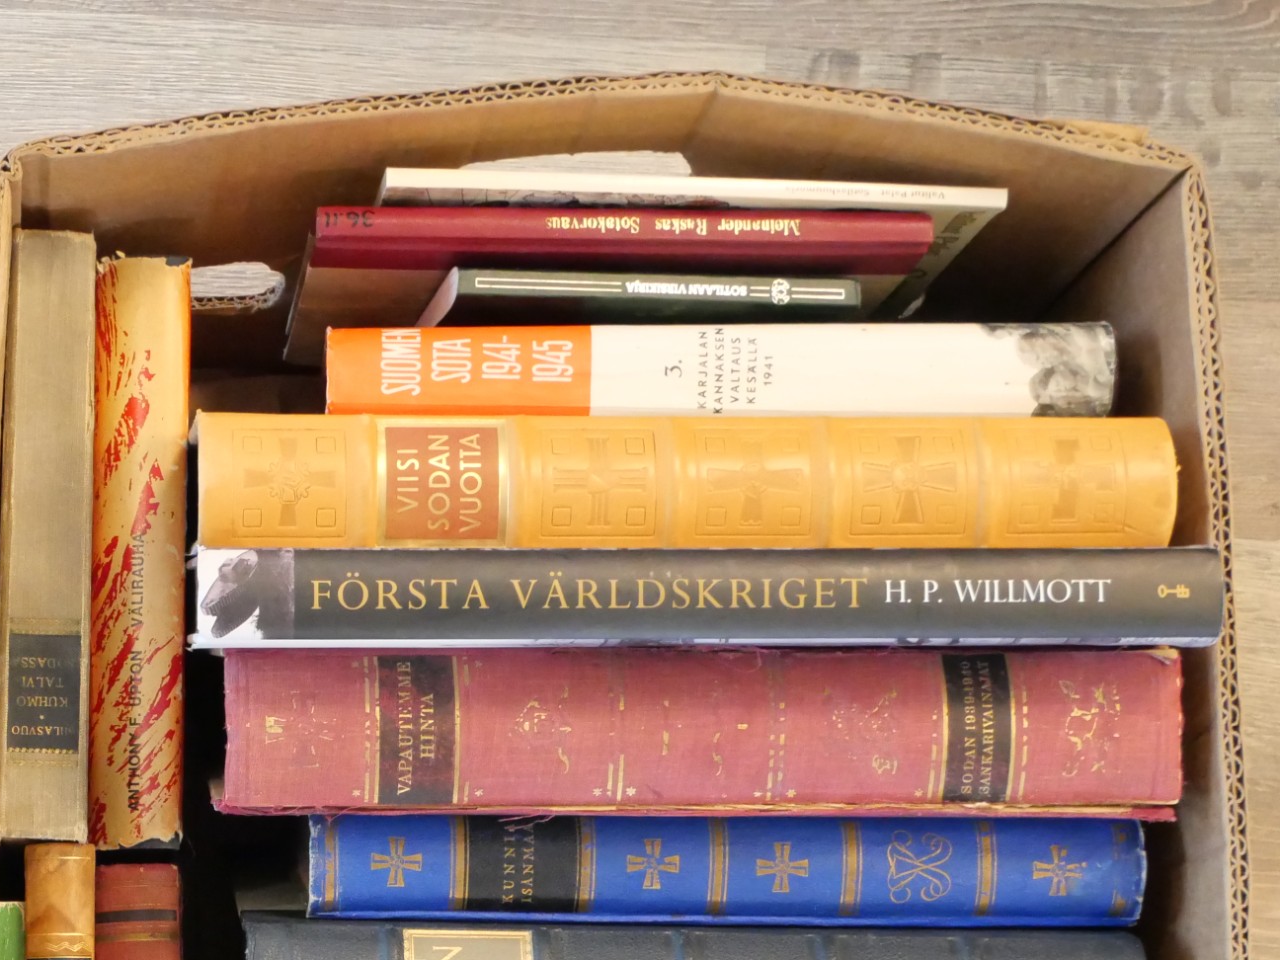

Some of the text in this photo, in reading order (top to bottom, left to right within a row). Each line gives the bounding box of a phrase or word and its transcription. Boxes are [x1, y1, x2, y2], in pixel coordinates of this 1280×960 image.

[544, 215, 801, 236] Meinander Raskas Sotakorvaus
[625, 280, 748, 297] SOTILAAN VIRSIKIRJA
[380, 328, 422, 396] SUOMEN
[430, 338, 472, 384] SOTA
[481, 335, 522, 380] 1941-
[532, 339, 574, 383] 1945
[663, 359, 683, 379] 3.
[697, 331, 708, 409] KARJALAN
[712, 327, 724, 415] KANNAKSEN
[729, 337, 741, 404] VALTAUS
[763, 356, 774, 387] 1941
[396, 449, 421, 513] VIISI
[427, 434, 451, 531] SODAN
[458, 432, 483, 534] VUOTTA
[310, 570, 1111, 610] FÖRSTA VÄRLDSKRIGET H. P. WILLMOTT
[16, 696, 68, 708] KUHMO
[21, 675, 64, 688] TALVI
[126, 534, 145, 811] ANTHONY F. UPTON VÄLIRAUHA
[396, 661, 414, 796] VAPAUTEMME
[420, 692, 435, 759] HINTA
[961, 736, 977, 795] SODAN
[502, 823, 517, 904] KUNNIA
